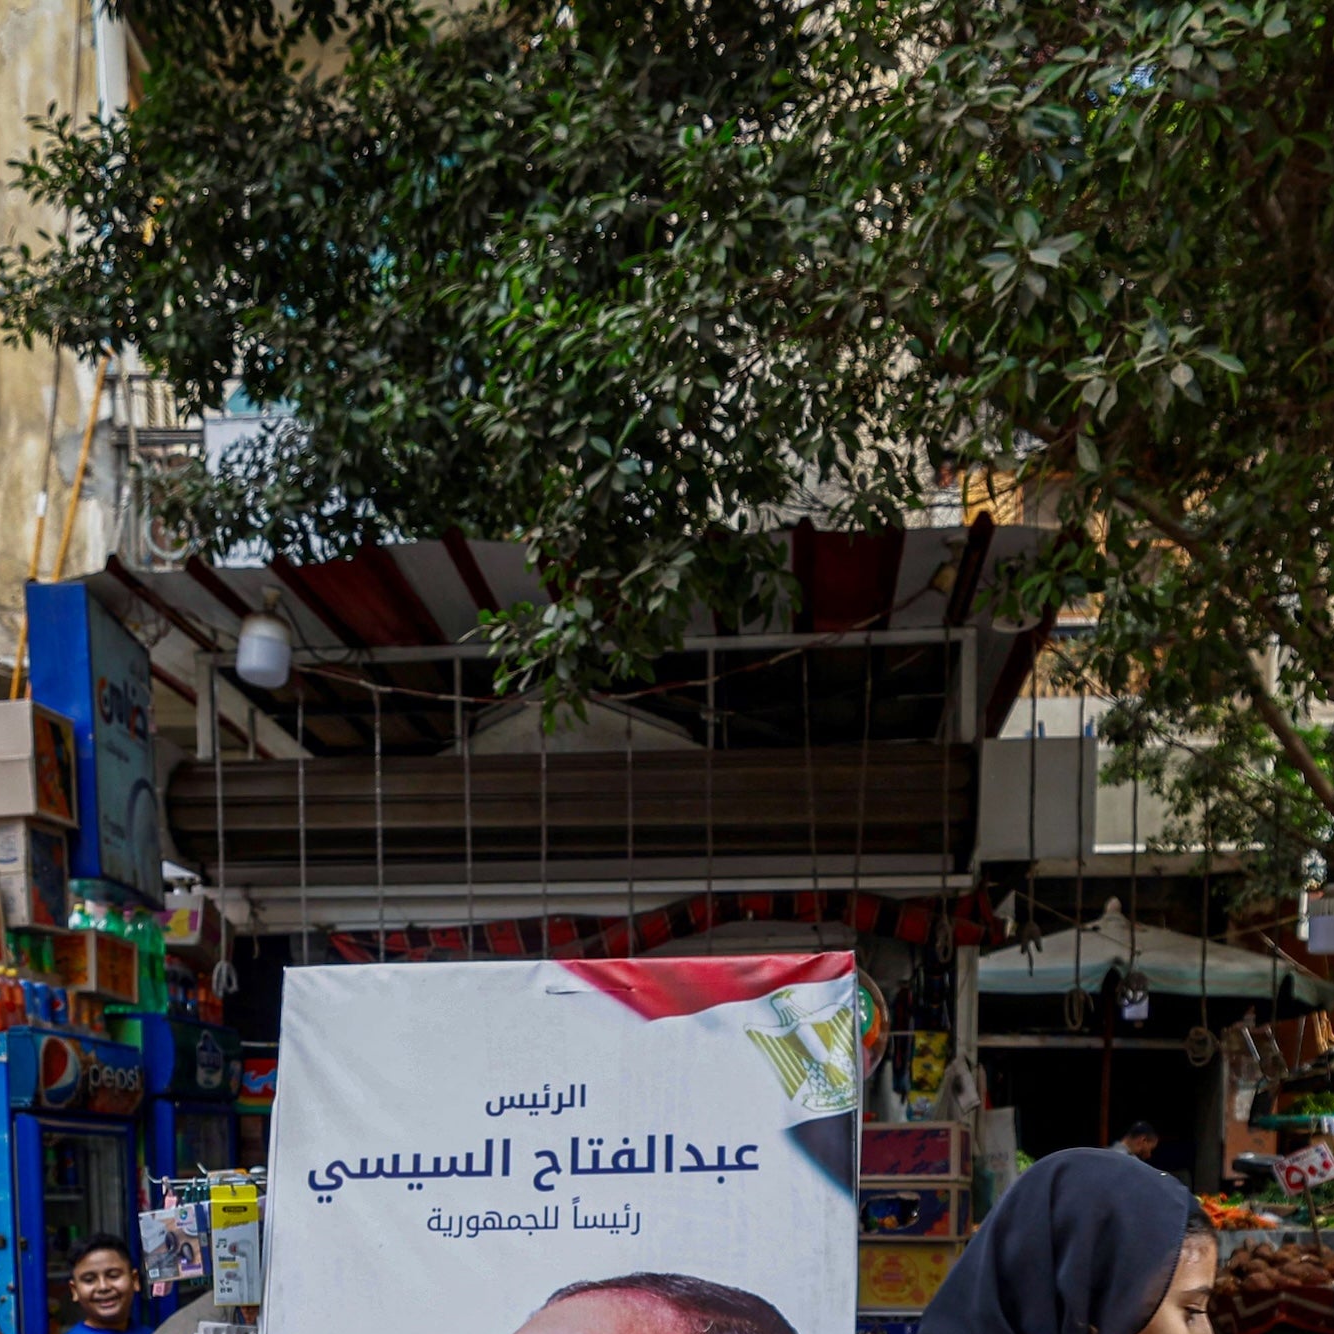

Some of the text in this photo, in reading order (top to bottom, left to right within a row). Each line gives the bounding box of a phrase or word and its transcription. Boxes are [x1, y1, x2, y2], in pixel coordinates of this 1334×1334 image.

[88, 1063, 141, 1093] pepsi
[484, 1083, 587, 1118] الرئيس
[307, 1133, 760, 1204] عبدالفتاح السيسي
[426, 1196, 641, 1239] رئيساً للجمهورية
